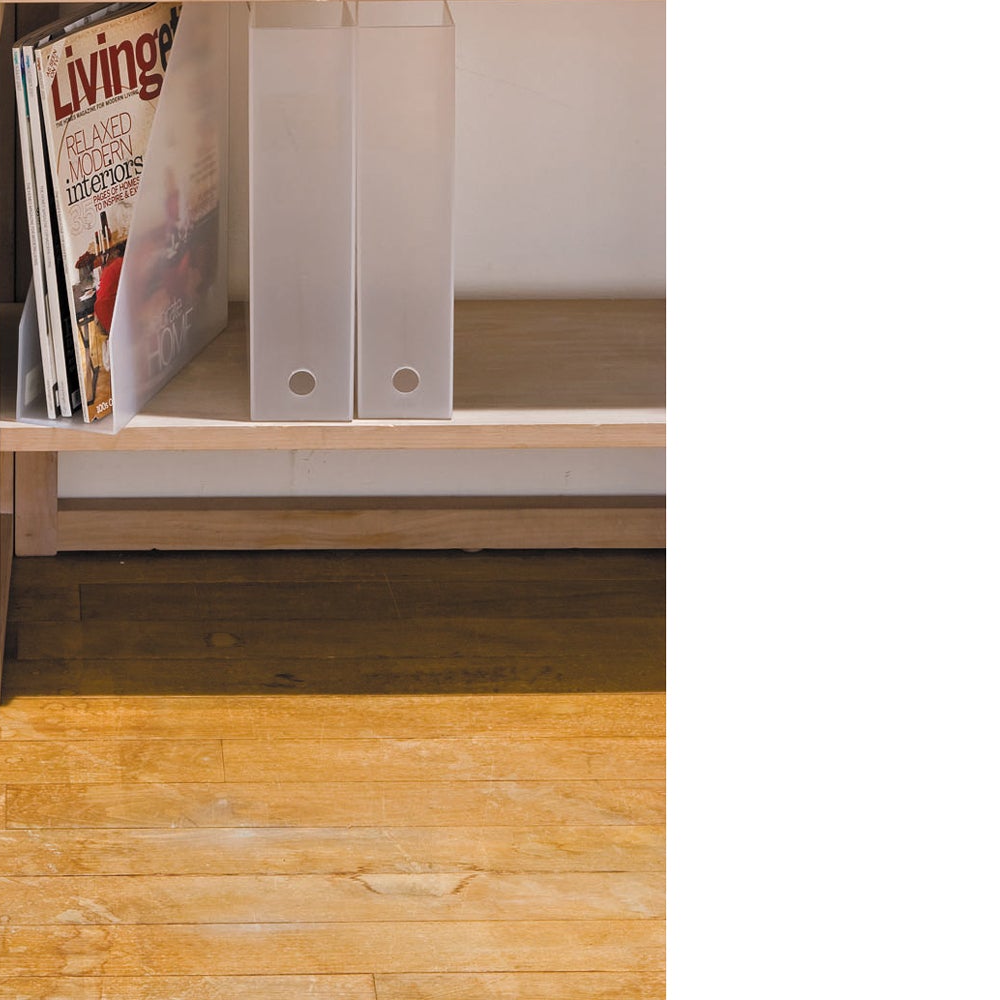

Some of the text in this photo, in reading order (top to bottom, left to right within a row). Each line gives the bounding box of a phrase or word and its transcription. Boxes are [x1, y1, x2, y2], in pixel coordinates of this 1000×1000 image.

[76, 107, 96, 118] MAGAZINE
[106, 96, 124, 106] MODERN
[124, 90, 139, 100] LIVING
[66, 112, 132, 159] RELAXED
[69, 134, 133, 182] MODERN
[66, 155, 144, 206] interiors
[92, 190, 111, 204] PAGES
[111, 186, 119, 195] OF
[94, 202, 102, 211] TO
[103, 193, 124, 208] INSPIRE
